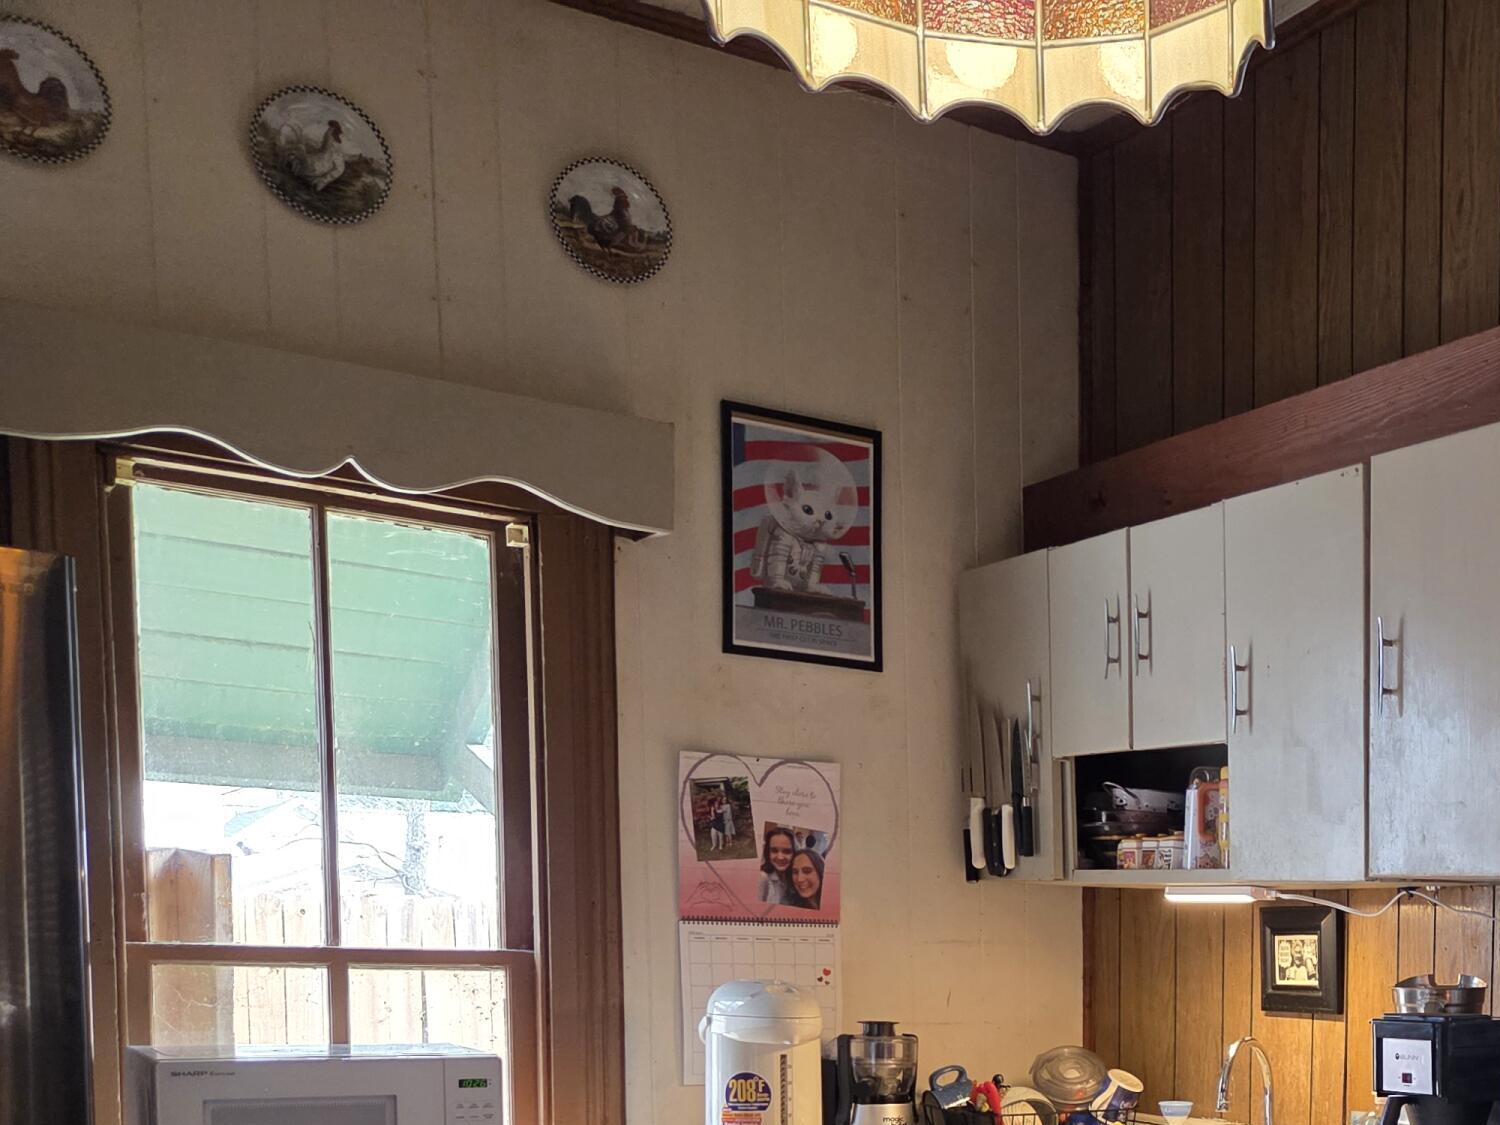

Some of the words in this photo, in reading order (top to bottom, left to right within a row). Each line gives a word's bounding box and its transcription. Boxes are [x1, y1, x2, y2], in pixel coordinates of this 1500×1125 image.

[763, 615, 788, 630] MR.
[791, 619, 842, 637] PEBBLES
[882, 1114, 904, 1123] magic
